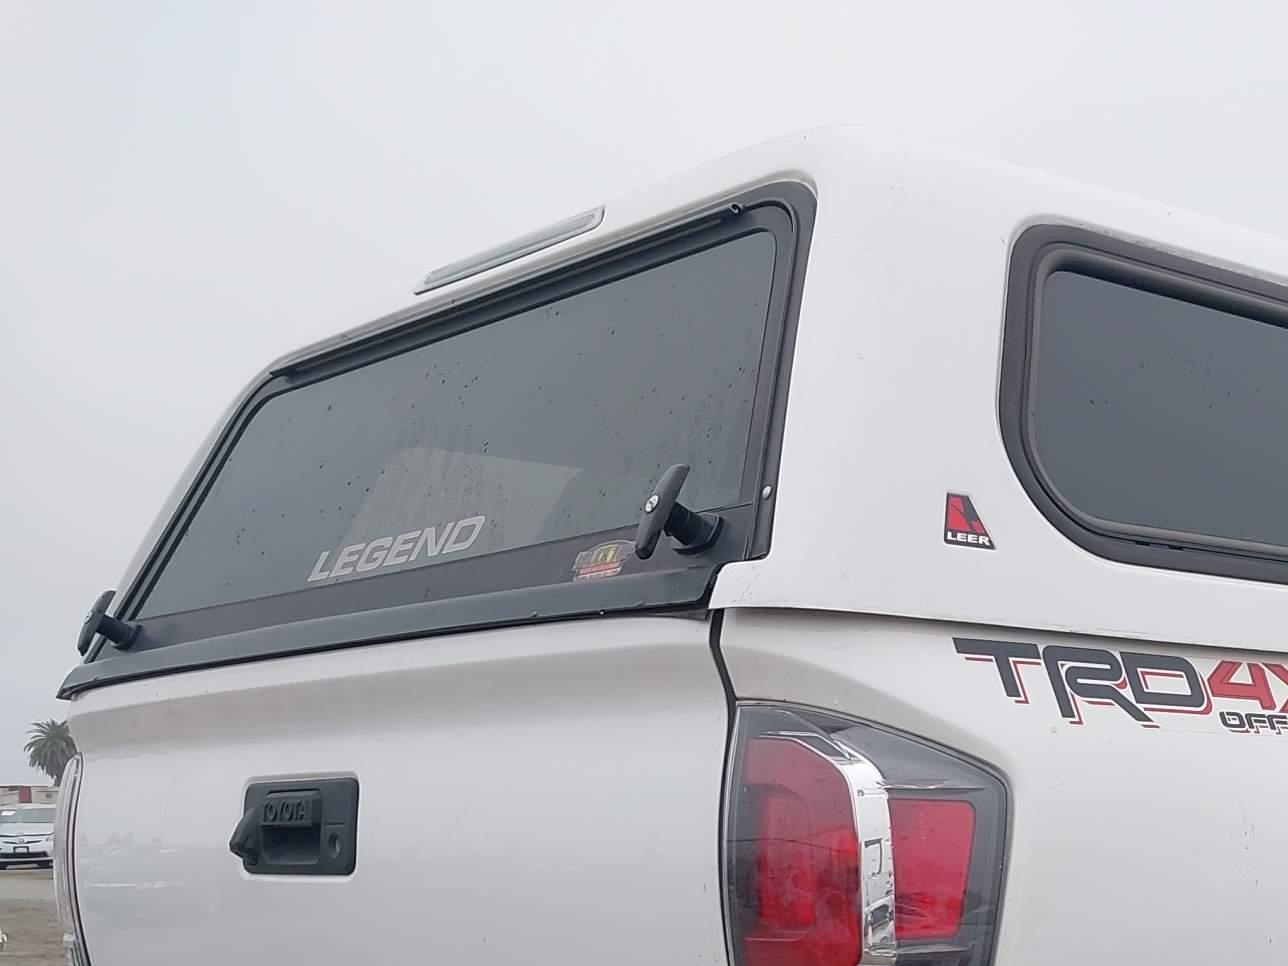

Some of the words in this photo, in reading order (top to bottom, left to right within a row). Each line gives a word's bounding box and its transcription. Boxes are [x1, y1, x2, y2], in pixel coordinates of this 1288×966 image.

[307, 515, 486, 582] LEGEND
[946, 530, 990, 547] LEER
[952, 637, 1213, 730] TRD
